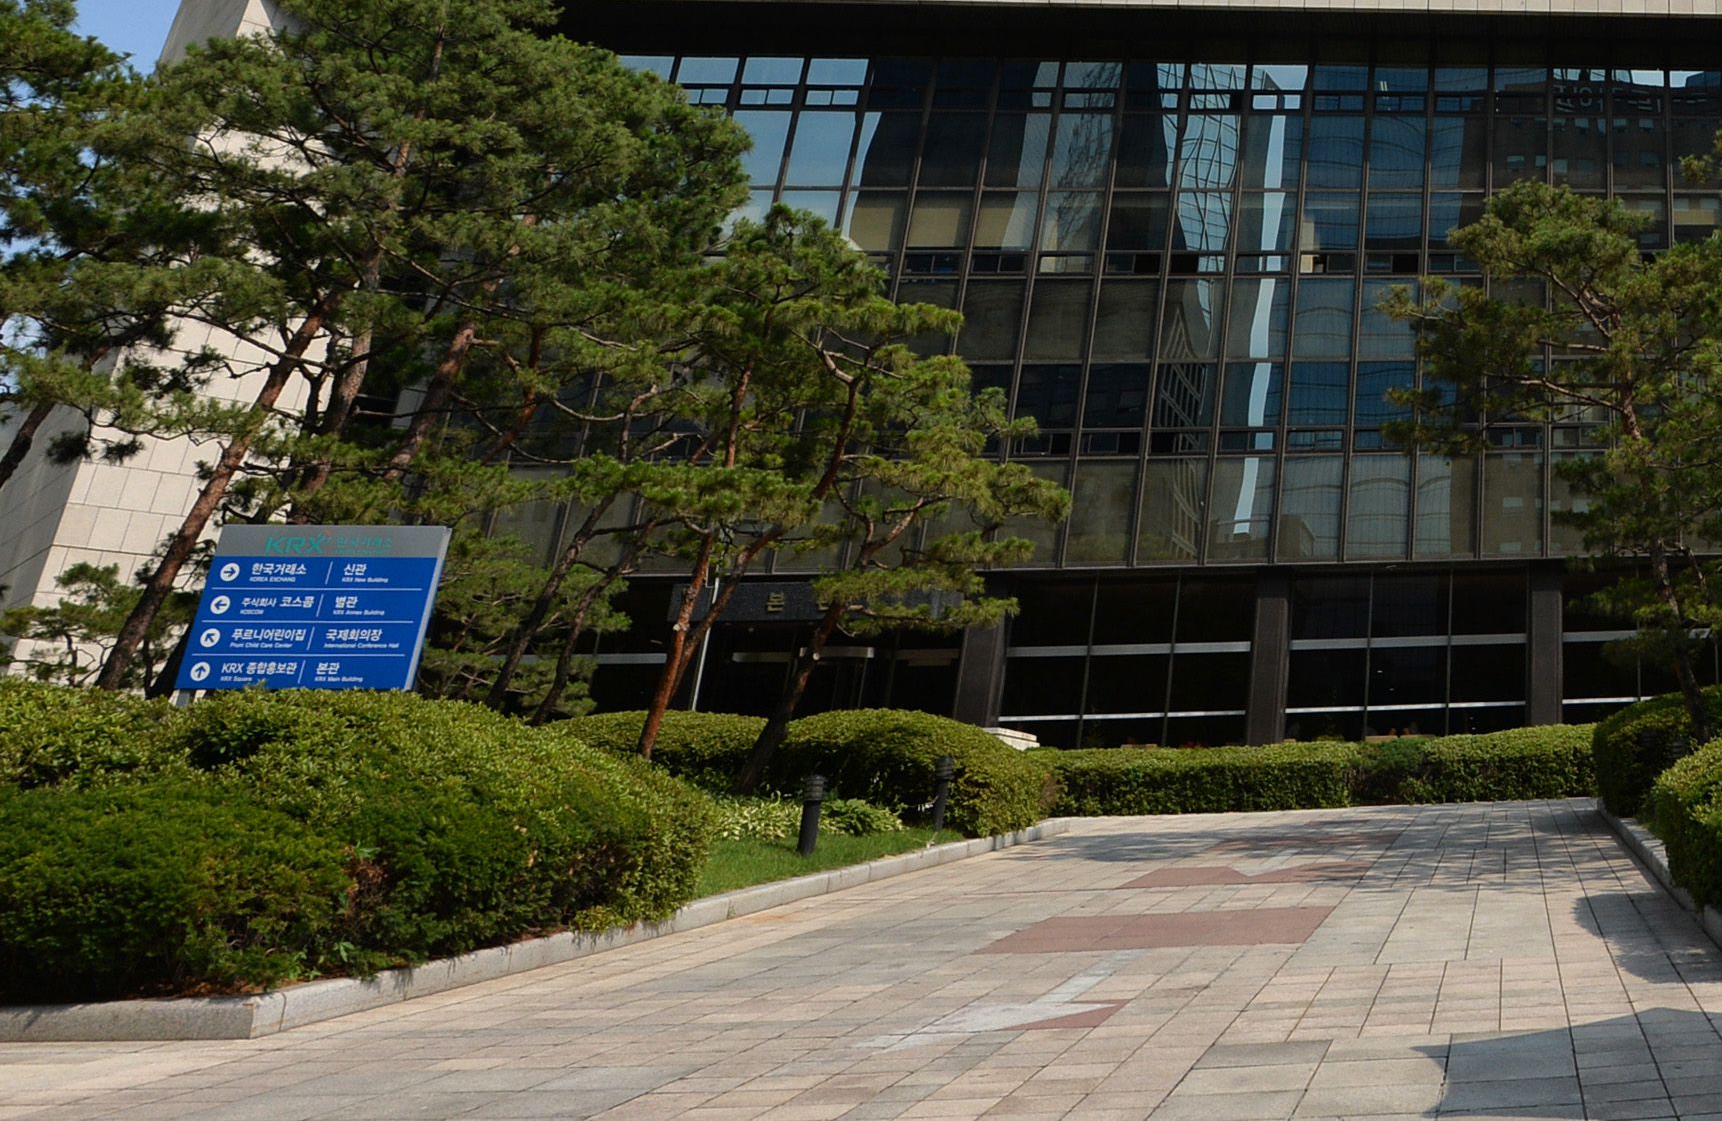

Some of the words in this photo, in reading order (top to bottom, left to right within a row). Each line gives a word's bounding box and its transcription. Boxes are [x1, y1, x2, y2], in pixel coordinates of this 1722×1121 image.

[265, 534, 324, 554] KRX
[251, 562, 307, 576] 한국거래소
[343, 563, 368, 576] 신관
[231, 628, 307, 641] 푸르니어린이집
[326, 628, 383, 642] 국제회의장
[221, 662, 245, 674] KRX
[316, 662, 340, 675] 본관
